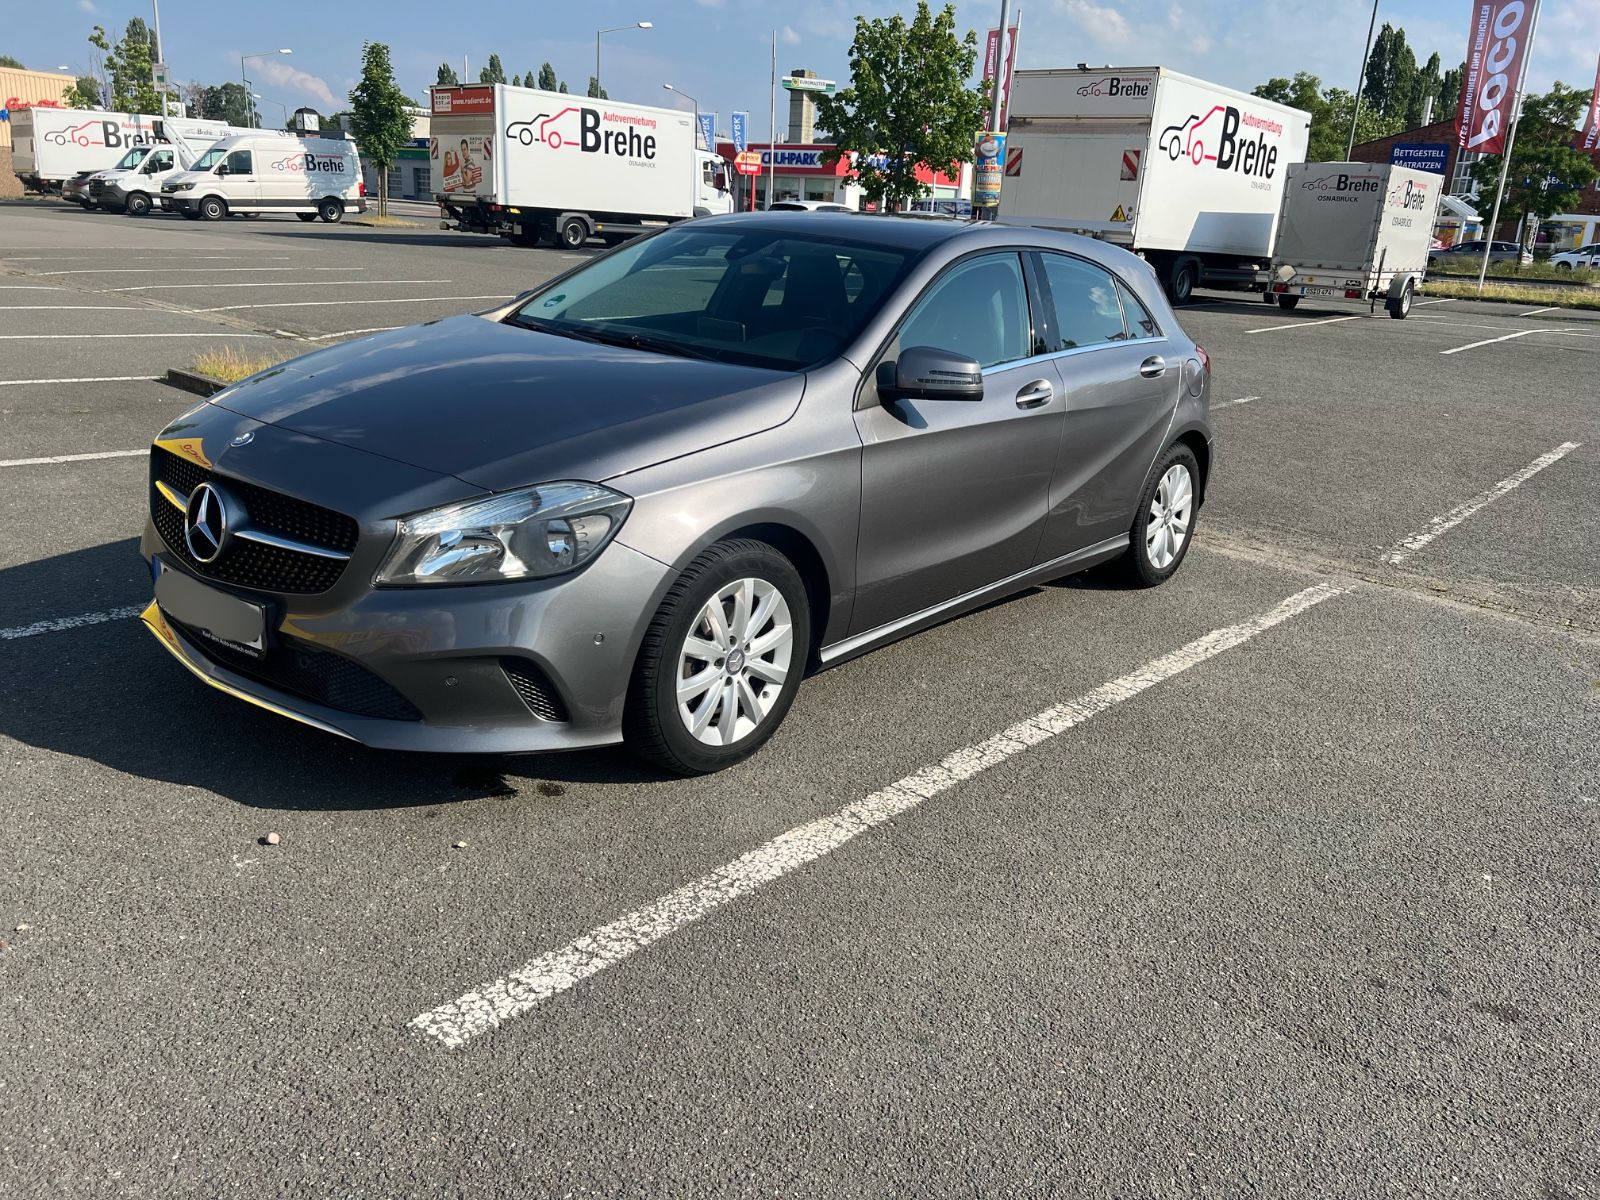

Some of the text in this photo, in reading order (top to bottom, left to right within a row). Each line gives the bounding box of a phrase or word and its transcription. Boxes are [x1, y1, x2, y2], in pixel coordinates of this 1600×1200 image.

[1109, 78, 1149, 96] Brehe
[603, 111, 657, 129] Autovermietung
[1241, 112, 1283, 137] Autovermietung
[581, 107, 656, 160] Brehe
[1216, 105, 1278, 179] Brehe
[1393, 148, 1445, 158] BETTGESTELL
[305, 154, 344, 172] Brehe
[628, 160, 656, 168] OSNABRÜCK
[1336, 174, 1379, 192] Brehe
[1403, 180, 1425, 210] Brehe
